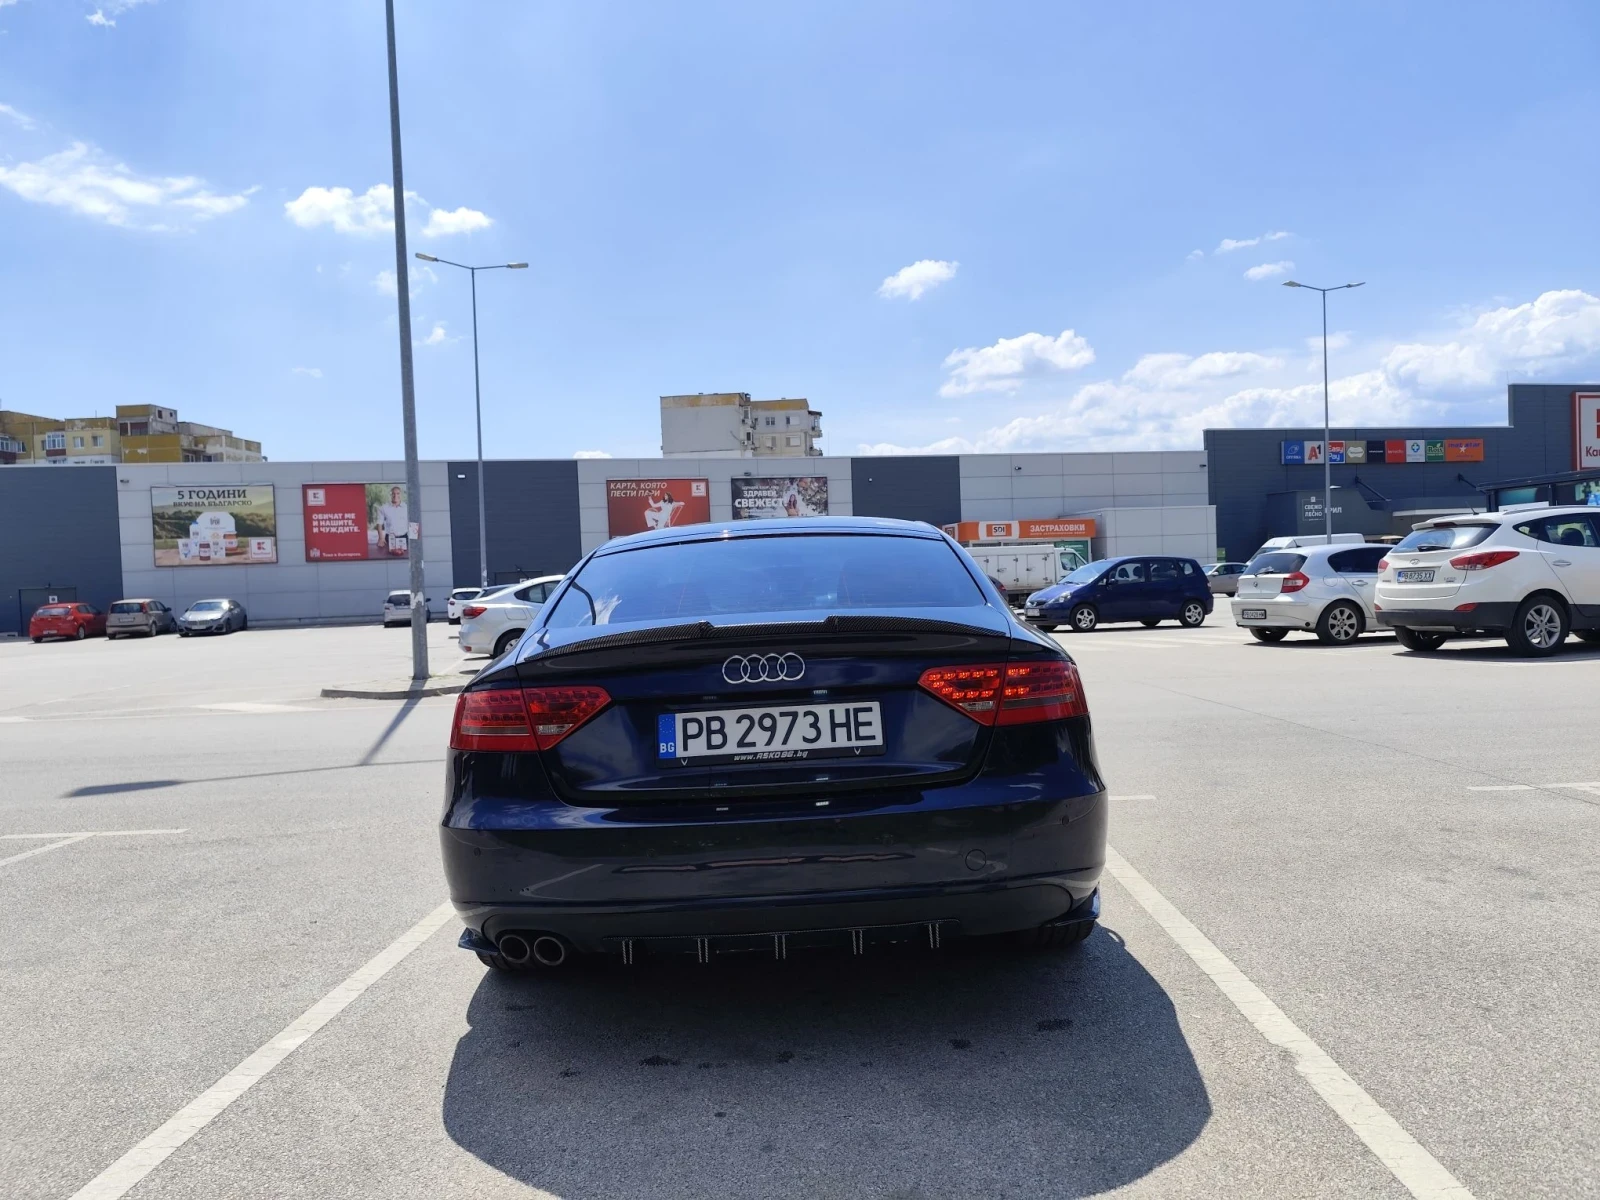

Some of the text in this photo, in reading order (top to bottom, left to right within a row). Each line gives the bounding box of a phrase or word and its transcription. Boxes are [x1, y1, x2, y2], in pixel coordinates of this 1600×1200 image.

[1308, 444, 1321, 460] A1
[610, 482, 638, 490] КАРТА,
[177, 489, 247, 500] 5 ГОДИНИ
[1029, 523, 1086, 533] ЗАСТРАХОВКИ
[682, 706, 876, 752] PB 2973 HE
[659, 742, 675, 753] BG
